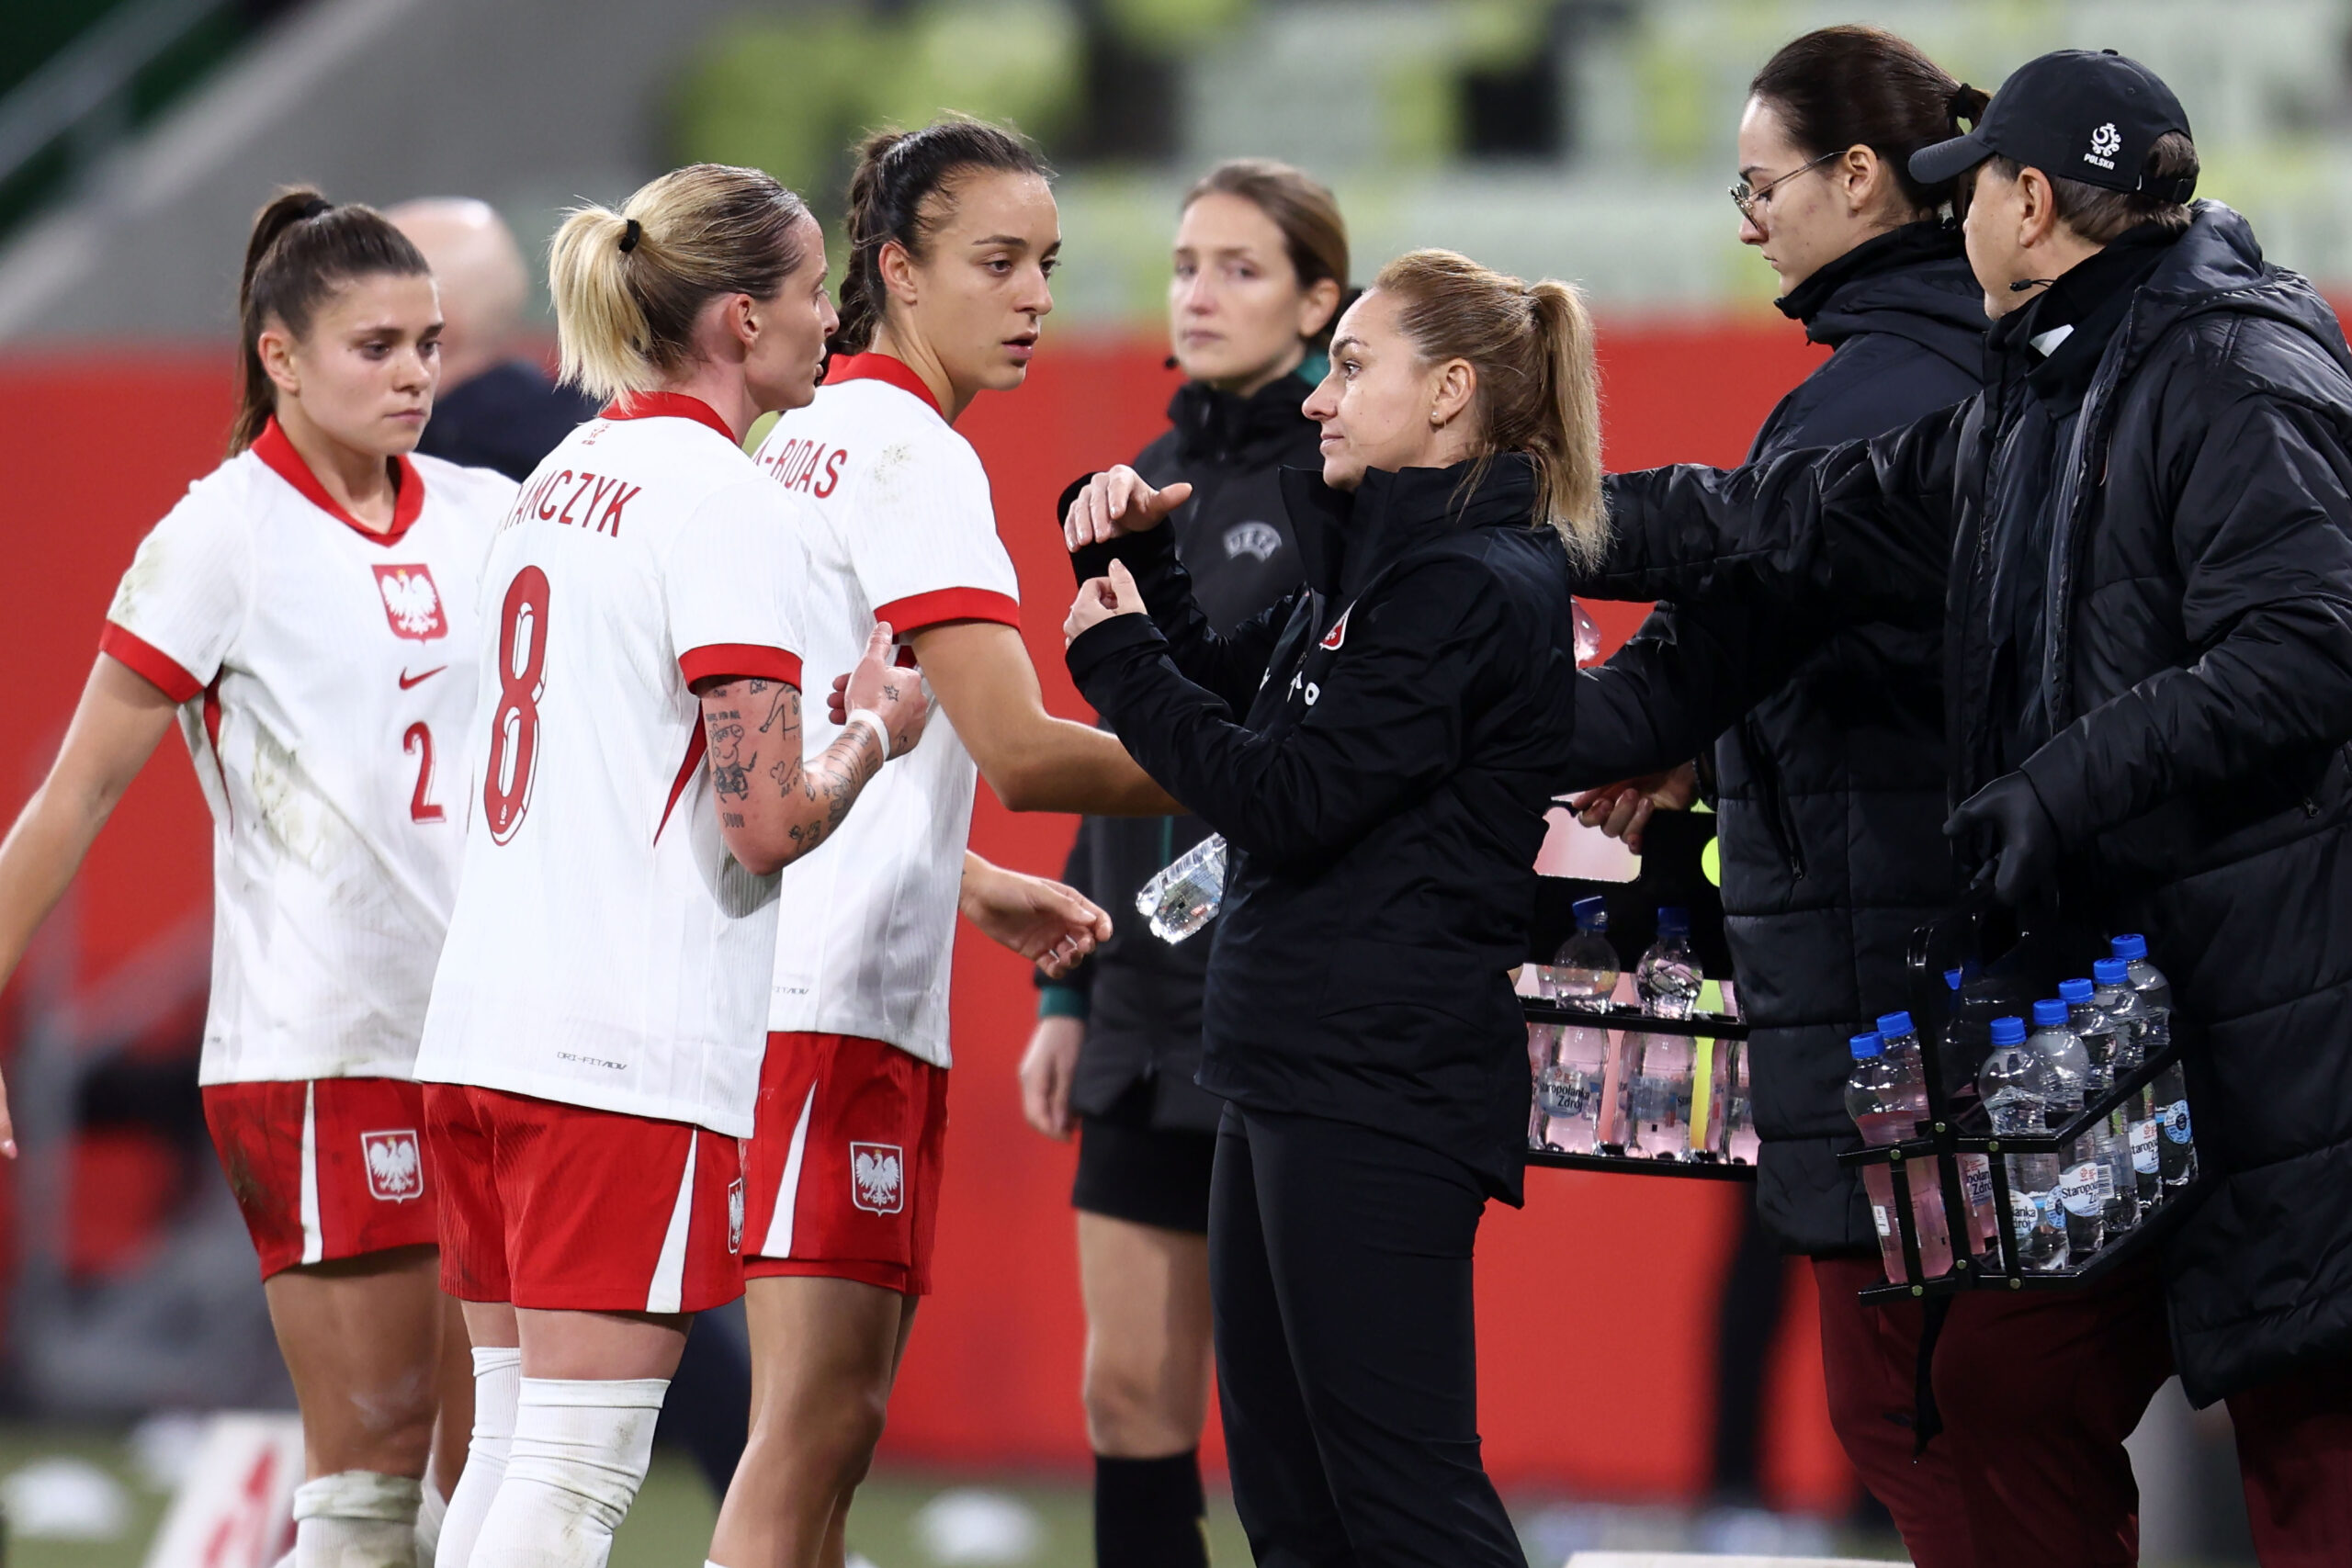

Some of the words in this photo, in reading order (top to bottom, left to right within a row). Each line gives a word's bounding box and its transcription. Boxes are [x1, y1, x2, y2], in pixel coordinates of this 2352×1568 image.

[2084, 153, 2115, 170] POLSKA
[484, 565, 550, 846] 8
[403, 720, 447, 825] 2
